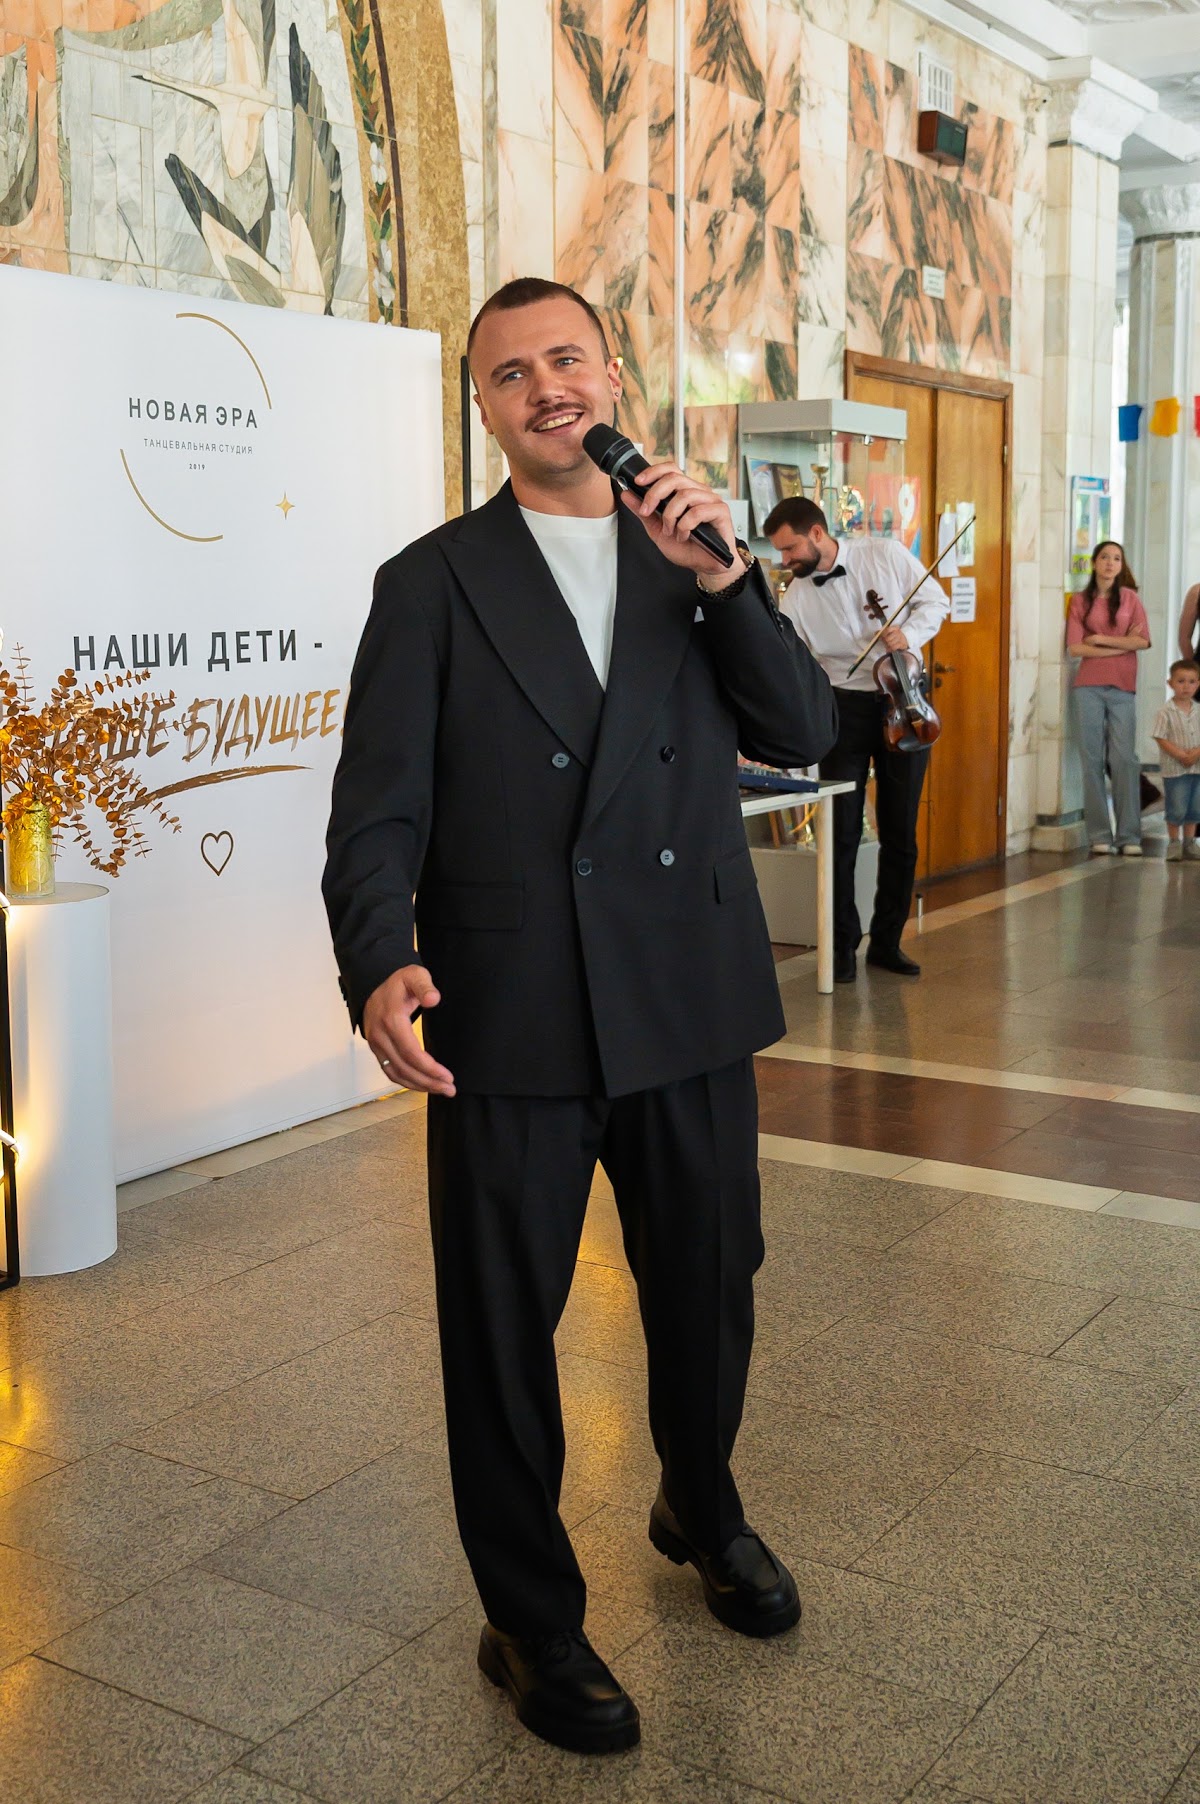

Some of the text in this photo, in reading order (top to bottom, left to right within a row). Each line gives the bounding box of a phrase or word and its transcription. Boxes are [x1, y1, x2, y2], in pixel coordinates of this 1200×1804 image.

[128, 397, 258, 429] НОВАЯ ЭРА
[143, 438, 253, 455] ТАНЦЕВАЛЬНАЯ СТУДИЯ
[189, 463, 206, 471] 2019
[73, 632, 188, 671] НАШИ
[207, 629, 297, 672] ДЕТИ
[182, 686, 346, 766] БУДУЩЕЕ
